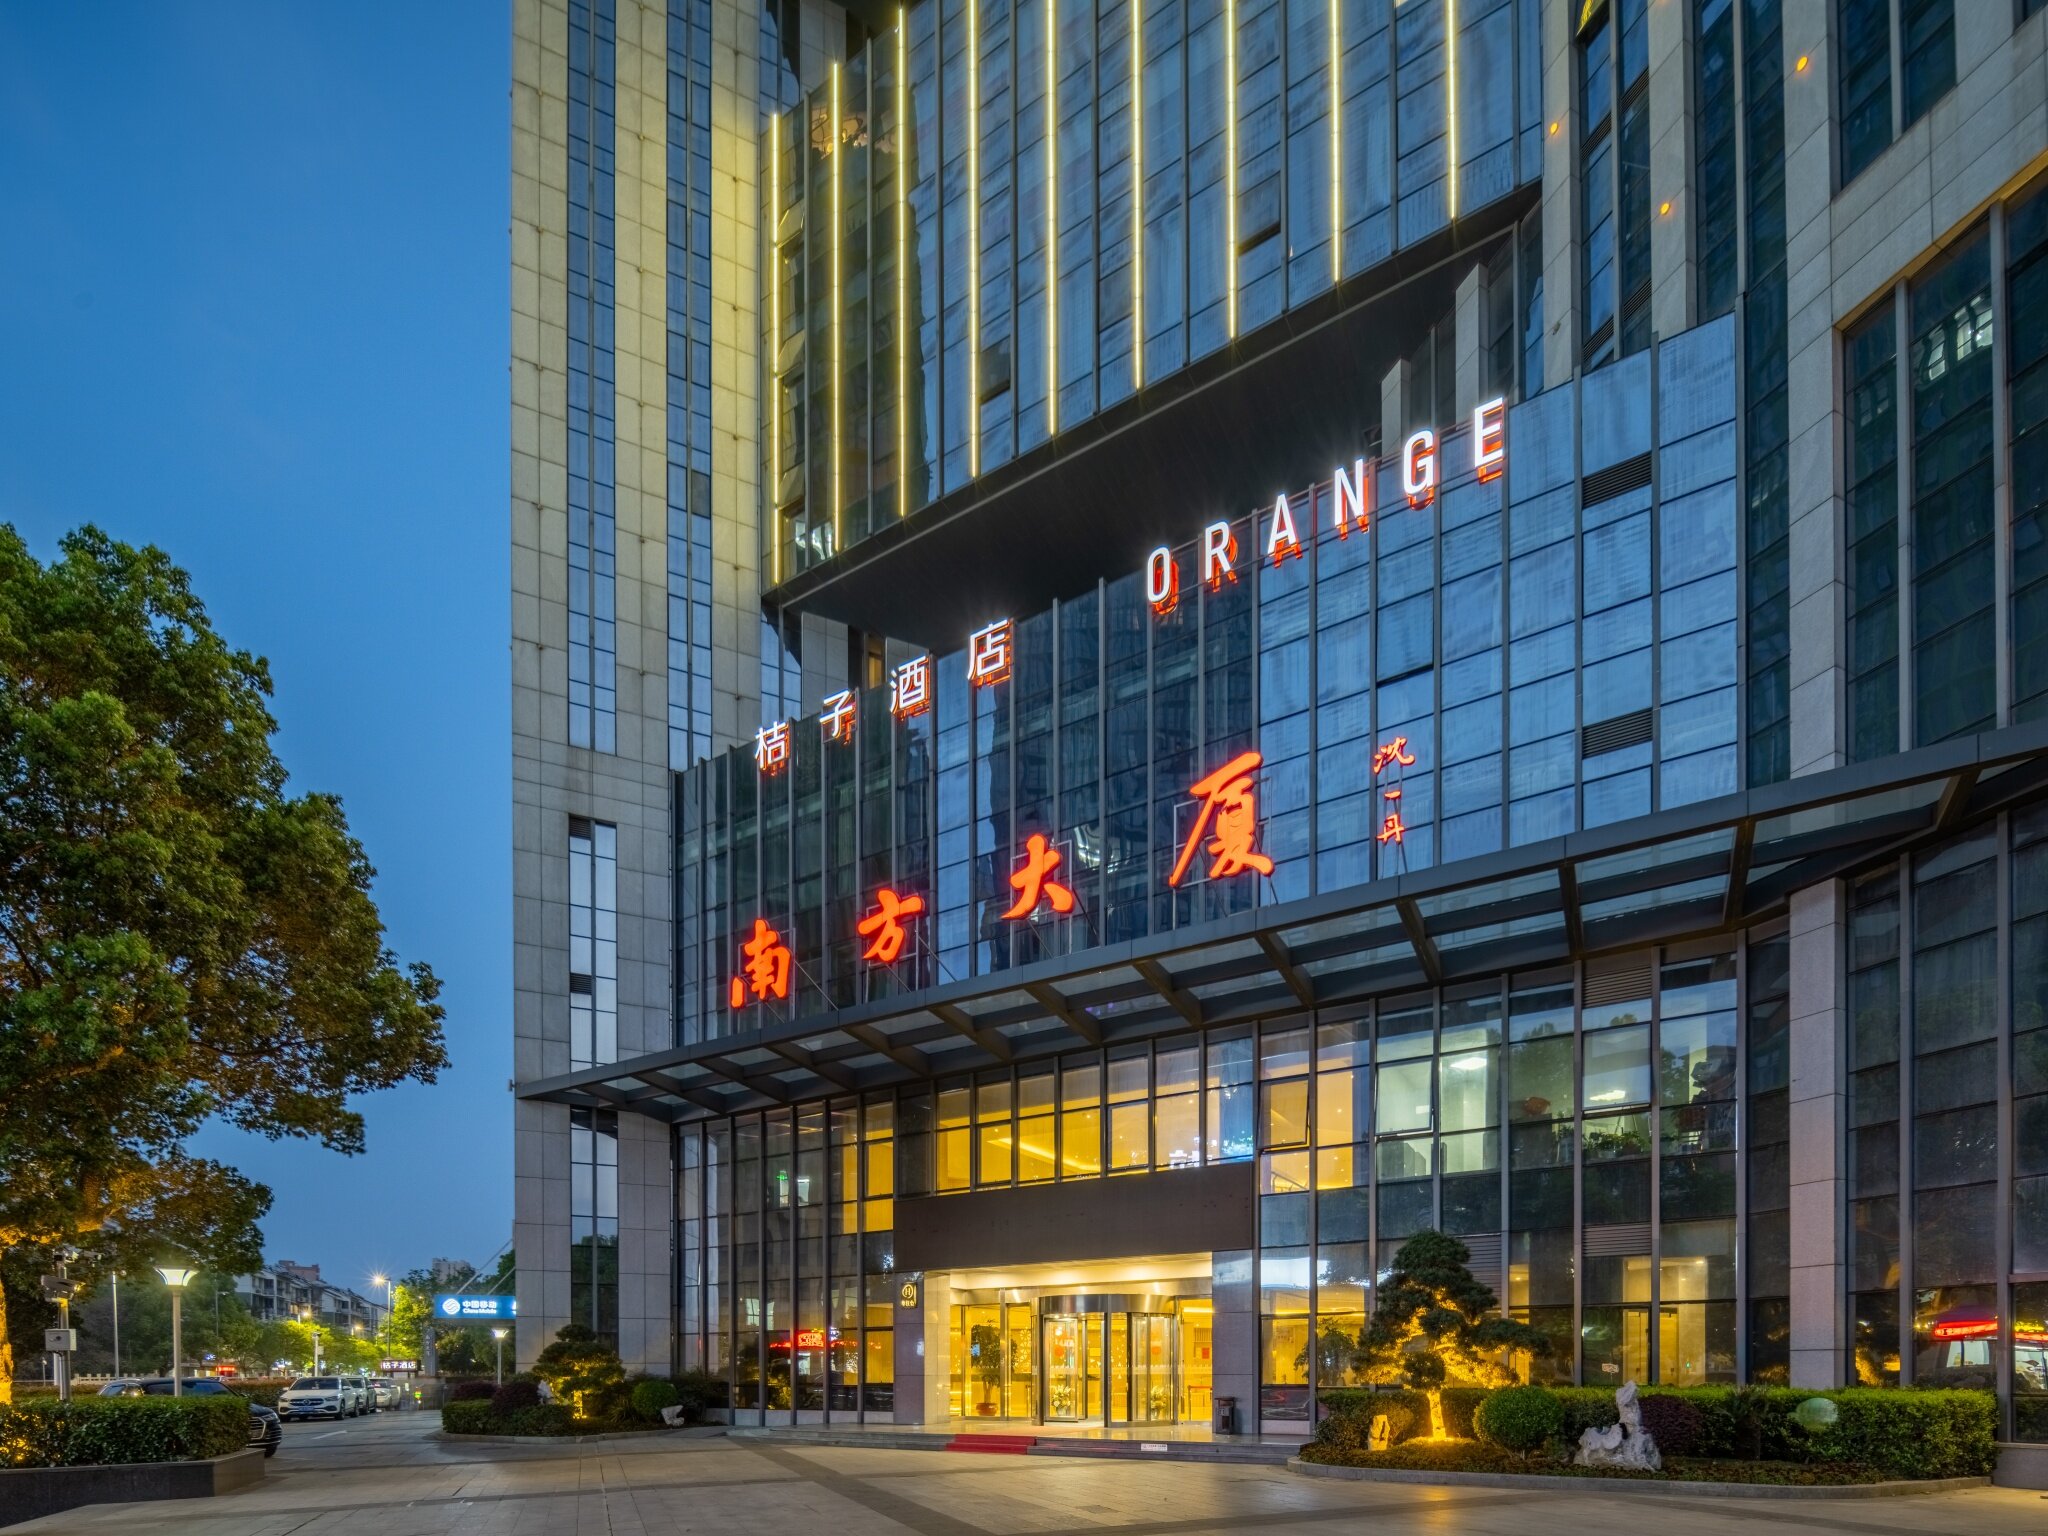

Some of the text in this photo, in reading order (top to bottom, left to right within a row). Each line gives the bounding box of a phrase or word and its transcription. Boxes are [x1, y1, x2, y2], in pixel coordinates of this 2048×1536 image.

[1147, 397, 1504, 604] ORANGE
[754, 619, 1009, 770] 桔子酒店
[731, 751, 1276, 1009] 南方大厦
